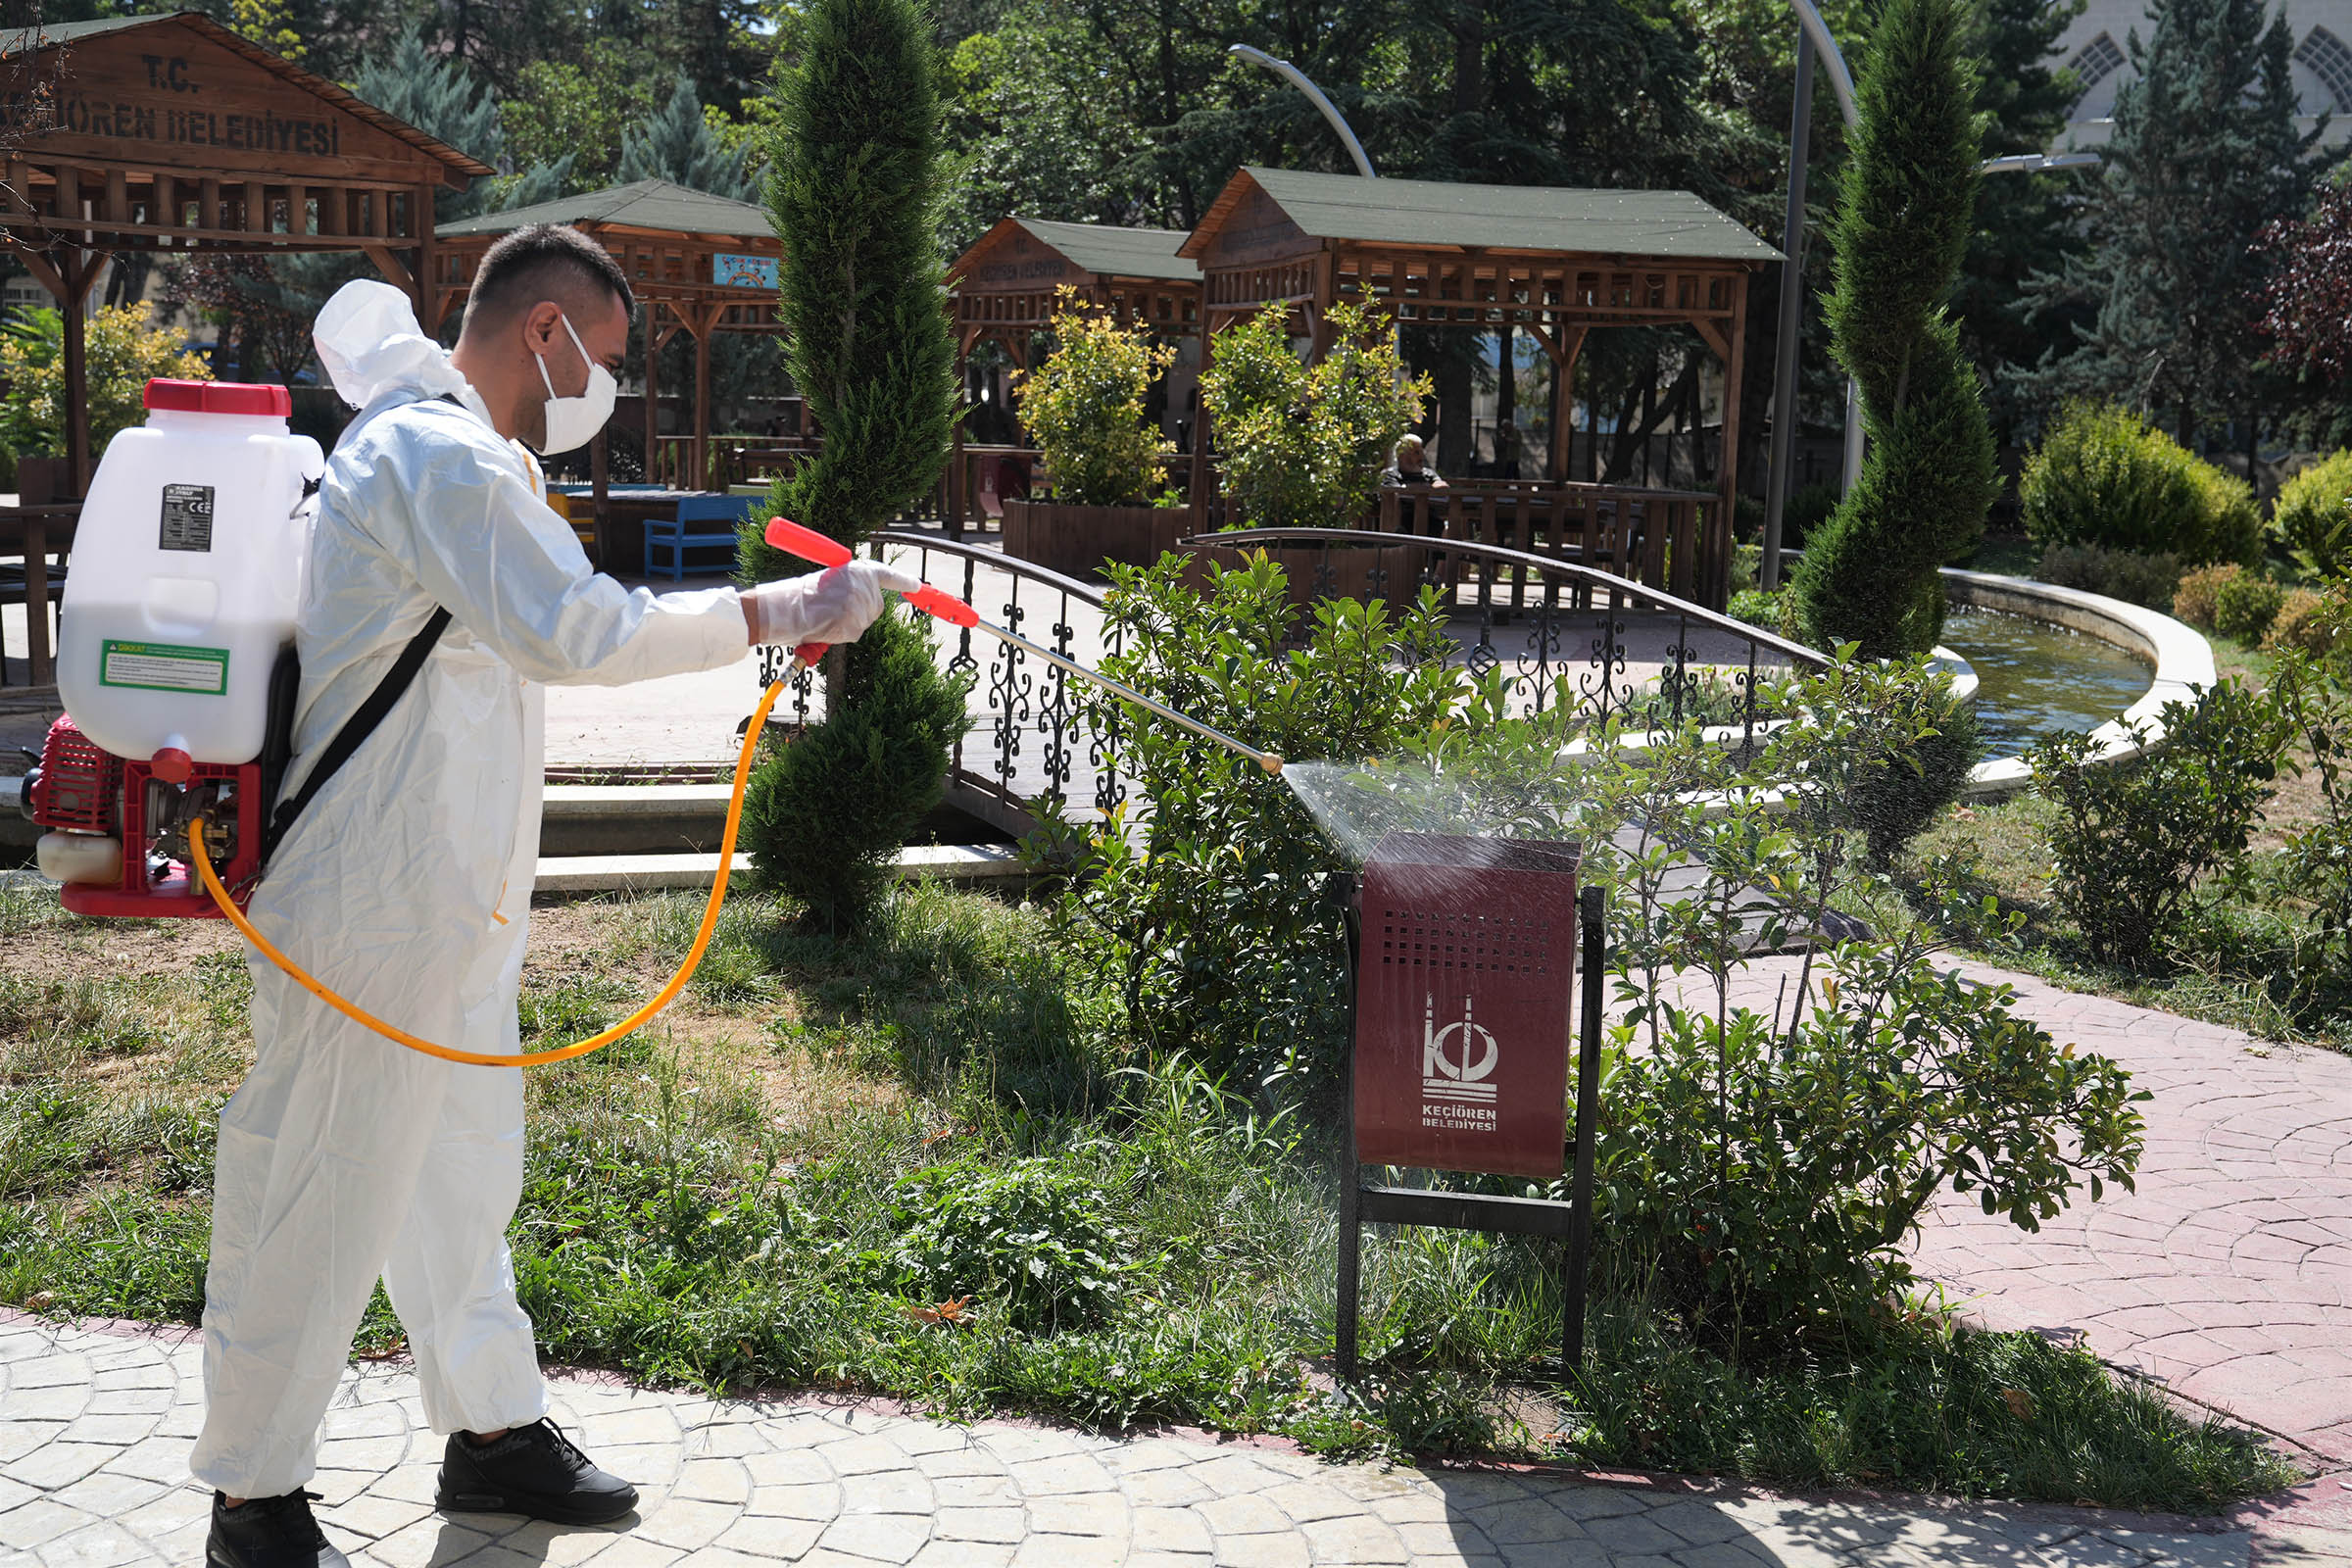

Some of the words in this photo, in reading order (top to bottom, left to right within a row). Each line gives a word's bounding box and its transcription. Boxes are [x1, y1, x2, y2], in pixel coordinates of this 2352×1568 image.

[142, 54, 202, 93] T.C.
[0, 88, 157, 141] EİÖREN
[168, 109, 338, 157] BELEDİYESİ
[1422, 1104, 1496, 1120] KEÇİÖREN
[1422, 1117, 1496, 1132] BELEDİYESİ
